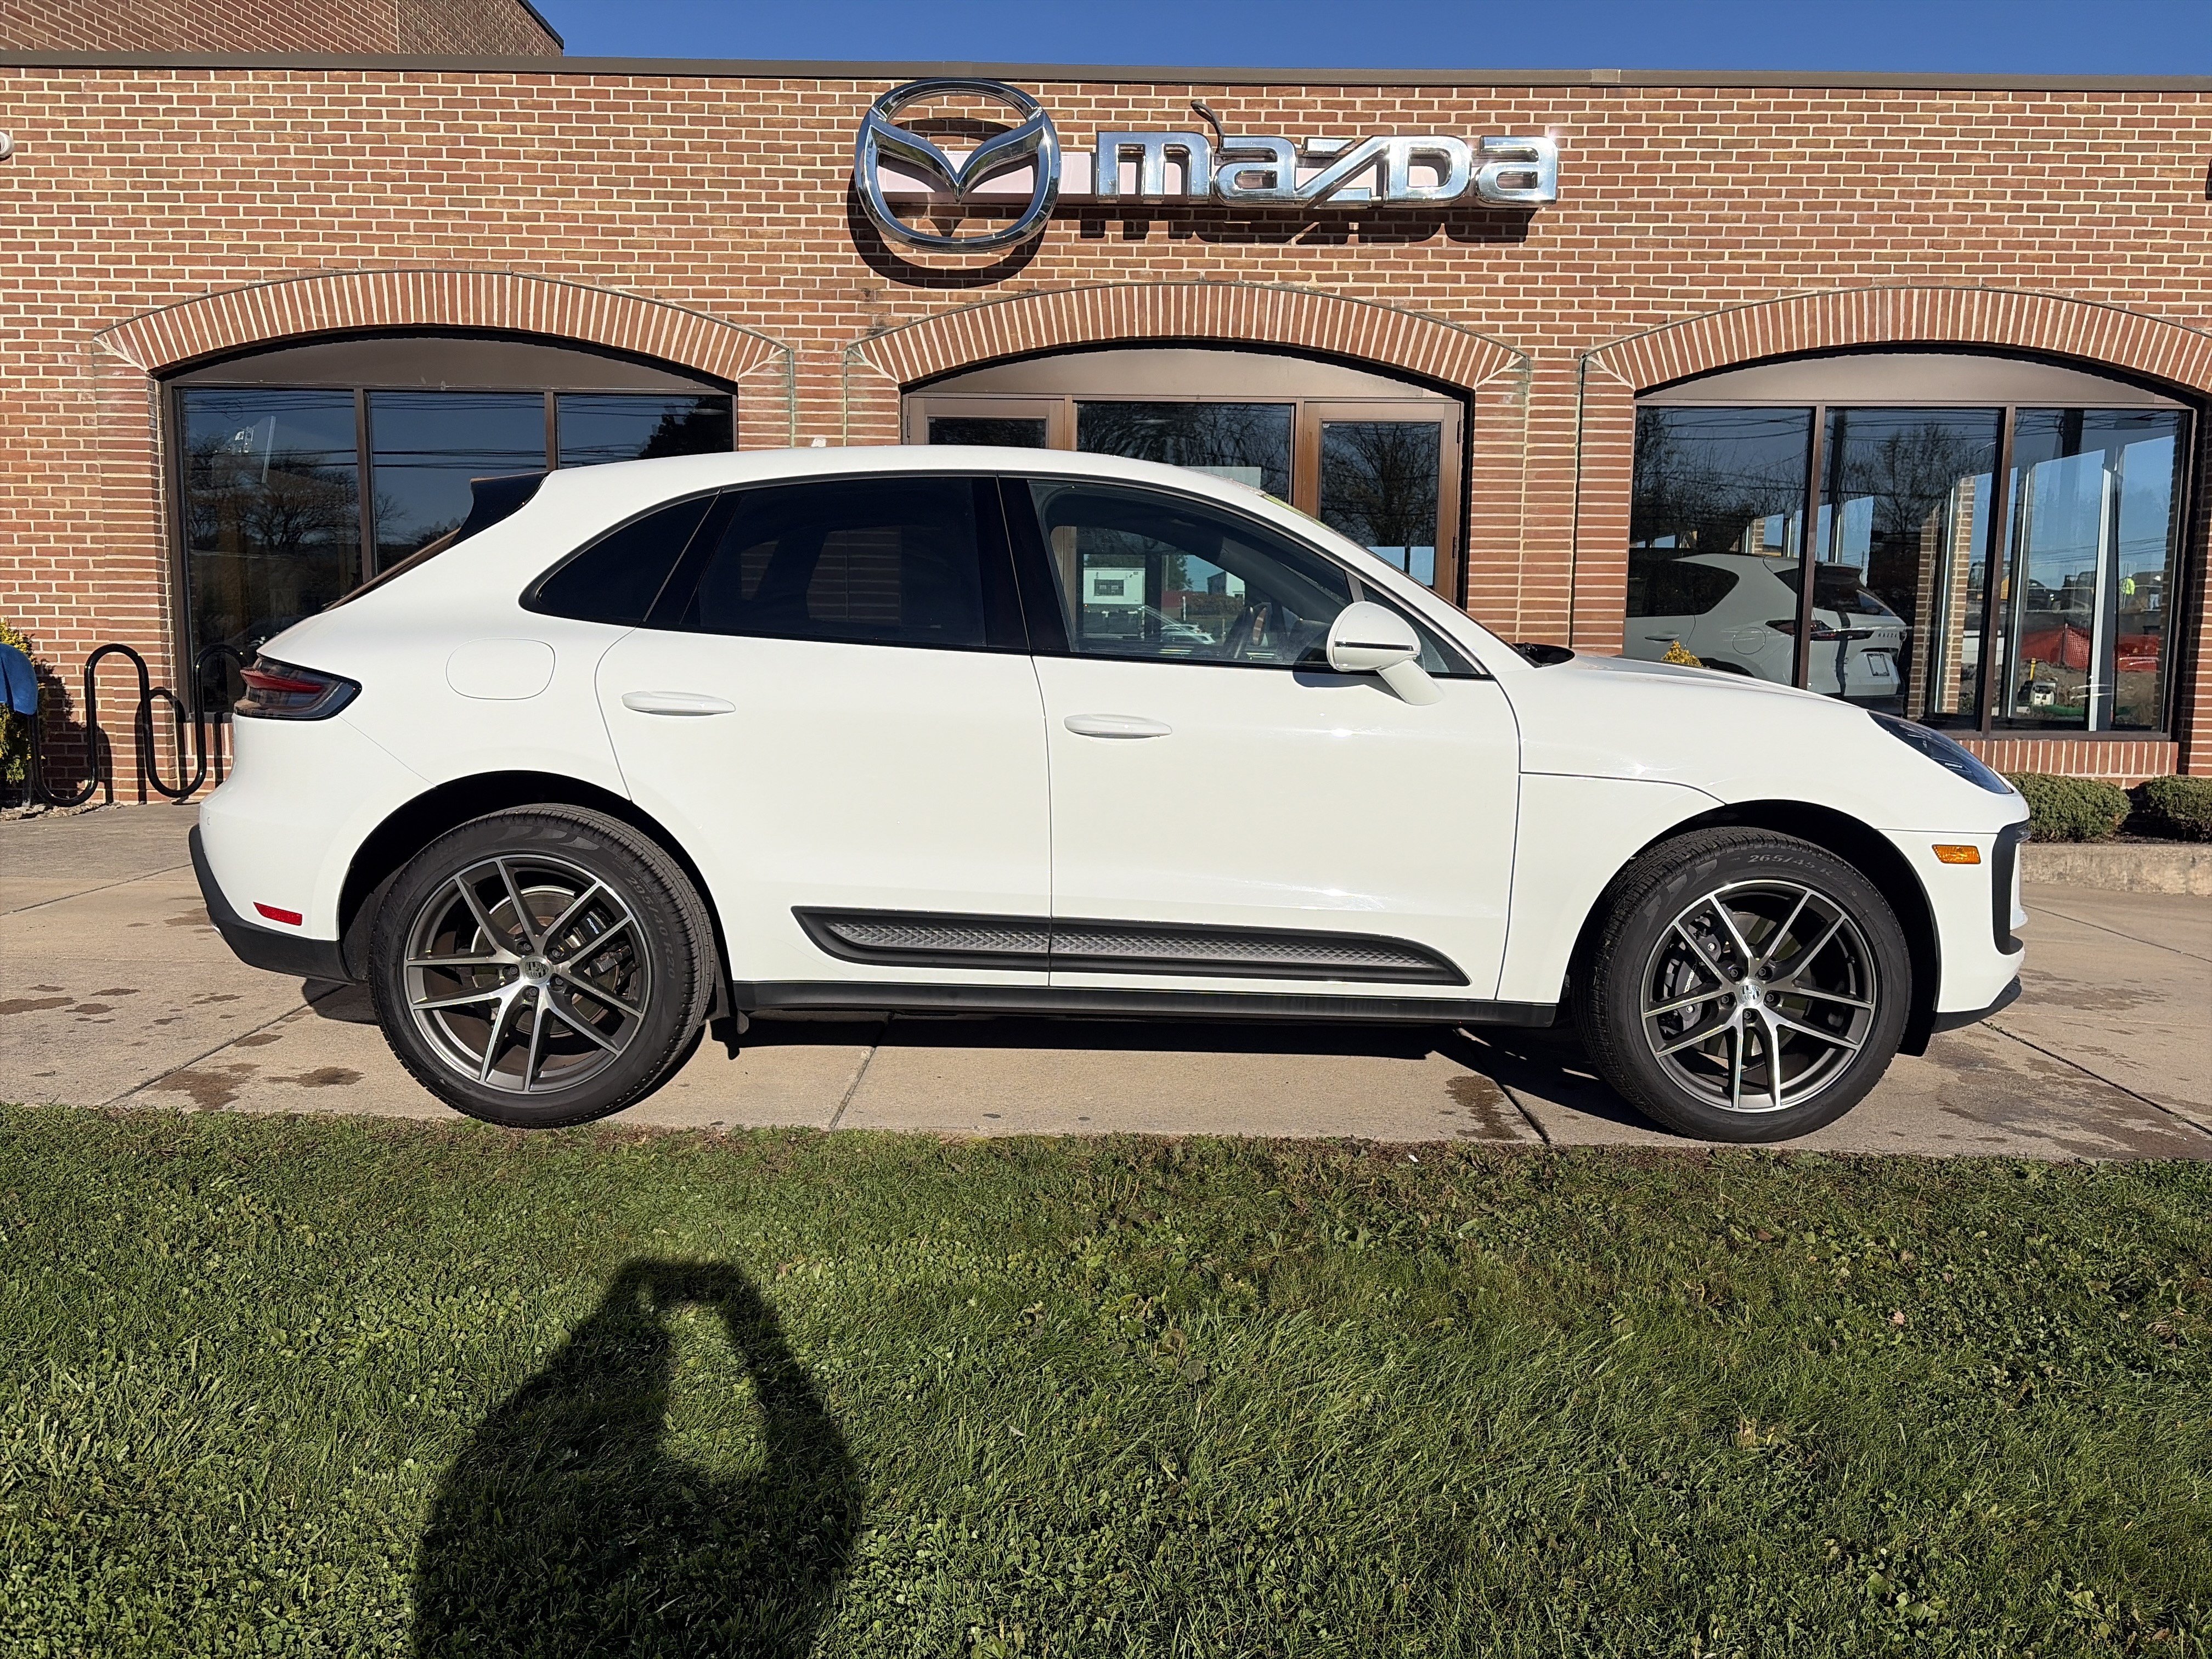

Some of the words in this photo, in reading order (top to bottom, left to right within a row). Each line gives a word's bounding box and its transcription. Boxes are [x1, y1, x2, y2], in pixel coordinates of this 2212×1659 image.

[1747, 854, 1815, 868] 265/45
[624, 877, 669, 936] 295/40
[663, 941, 675, 979] R20
